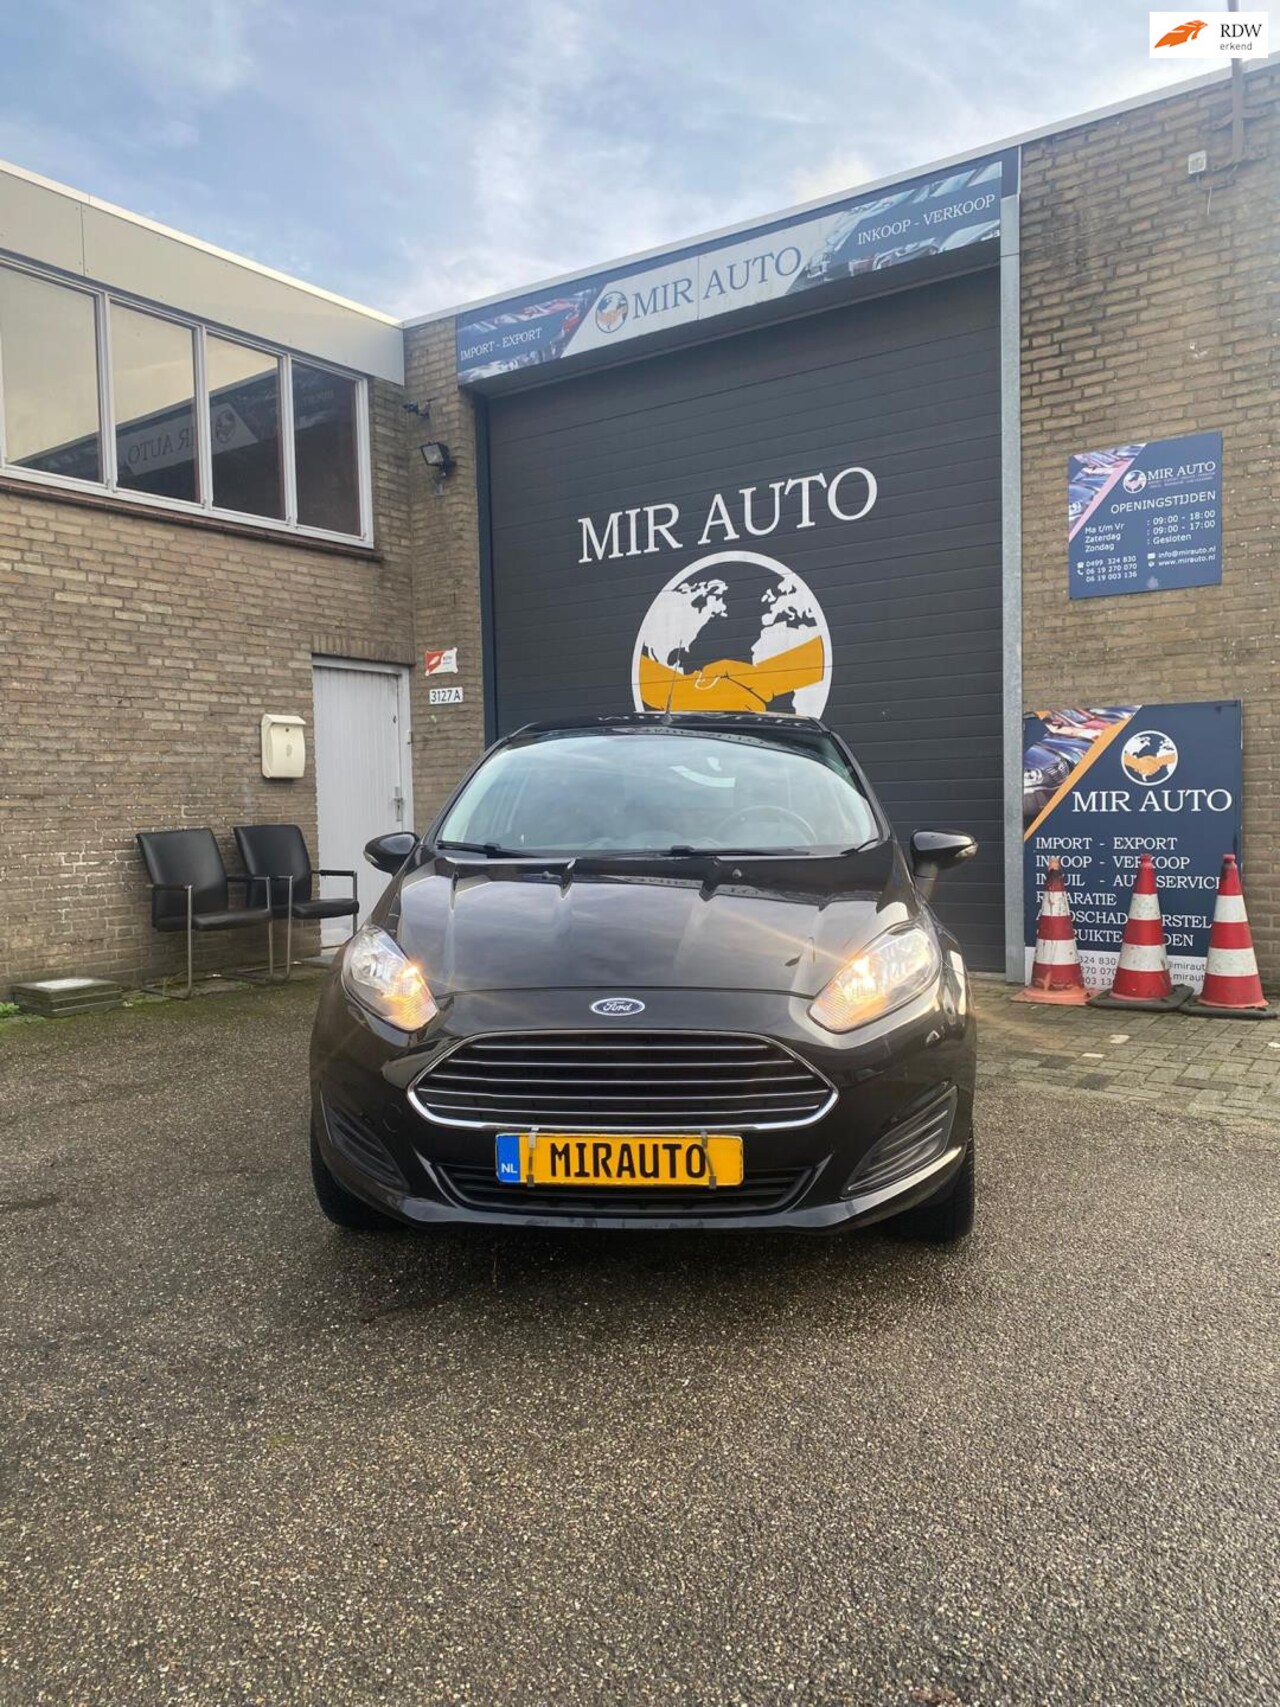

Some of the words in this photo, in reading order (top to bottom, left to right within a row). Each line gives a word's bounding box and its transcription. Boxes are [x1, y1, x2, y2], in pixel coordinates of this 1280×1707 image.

[857, 218, 911, 245] INKOOP
[923, 194, 995, 225] VERKOOP
[632, 277, 694, 320] MIR
[703, 246, 802, 300] AUTO
[460, 341, 495, 361] IMPORT
[502, 327, 543, 348] EXPORT
[1147, 467, 1174, 481] MIR
[1177, 460, 1216, 476] AUTO
[1110, 490, 1216, 514] OPENINGSTIJDEN
[577, 502, 683, 563] MIR
[697, 466, 878, 545] AUTO
[1085, 532, 1121, 544] Zaterdag
[1085, 543, 1115, 553] Zondag
[1153, 534, 1192, 545] Gesloten
[1072, 791, 1131, 812] MIR
[1139, 789, 1232, 812] AUTO
[1036, 837, 1093, 850] IMPORT
[1113, 836, 1178, 850] EXPORT
[1036, 855, 1093, 868] INOOP
[1036, 873, 1086, 886] INUIL
[501, 1163, 518, 1175] NL
[549, 1142, 706, 1180] MIRAUTO
